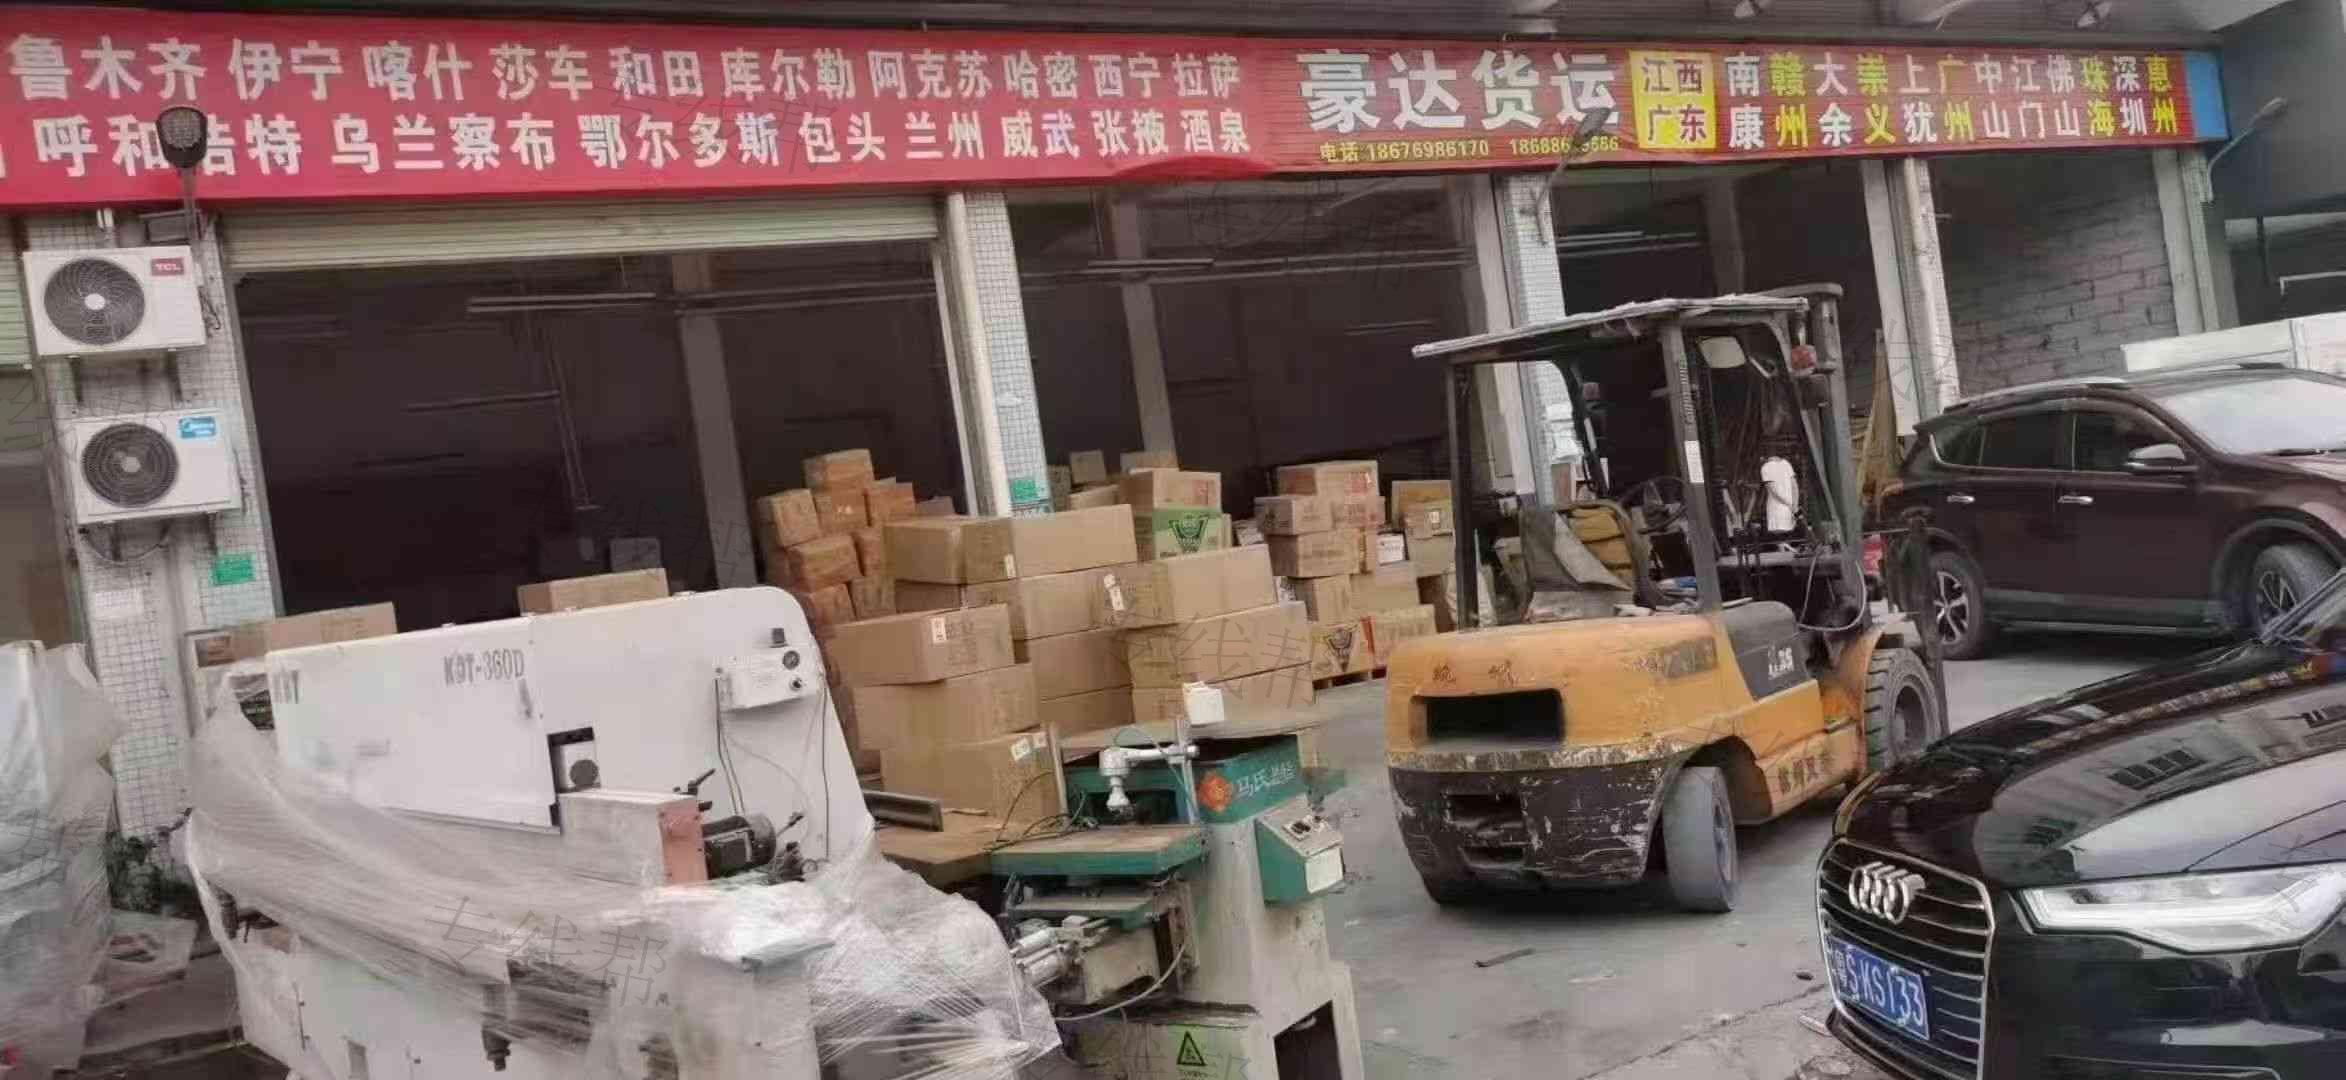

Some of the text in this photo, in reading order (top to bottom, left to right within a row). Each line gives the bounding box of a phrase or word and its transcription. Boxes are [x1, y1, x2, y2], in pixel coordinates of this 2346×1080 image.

[10, 33, 1241, 101] 鲁木齐 伊宁 喀什 莎车 和田 库尔勒 阿克苏 哈密 西宁 拉萨
[1296, 49, 1621, 134] 豪达货运
[1640, 55, 1704, 97] 江西
[331, 112, 559, 174] 乌兰察布
[577, 110, 781, 169] 鄂尔多斯
[799, 111, 886, 165] 包头
[904, 109, 985, 160] 兰州
[1002, 109, 1081, 159] 威武
[1090, 107, 1169, 158] 张掖
[1181, 107, 1252, 156] 酒泉
[1645, 104, 1707, 142] 广东
[155, 262, 182, 273] TCL
